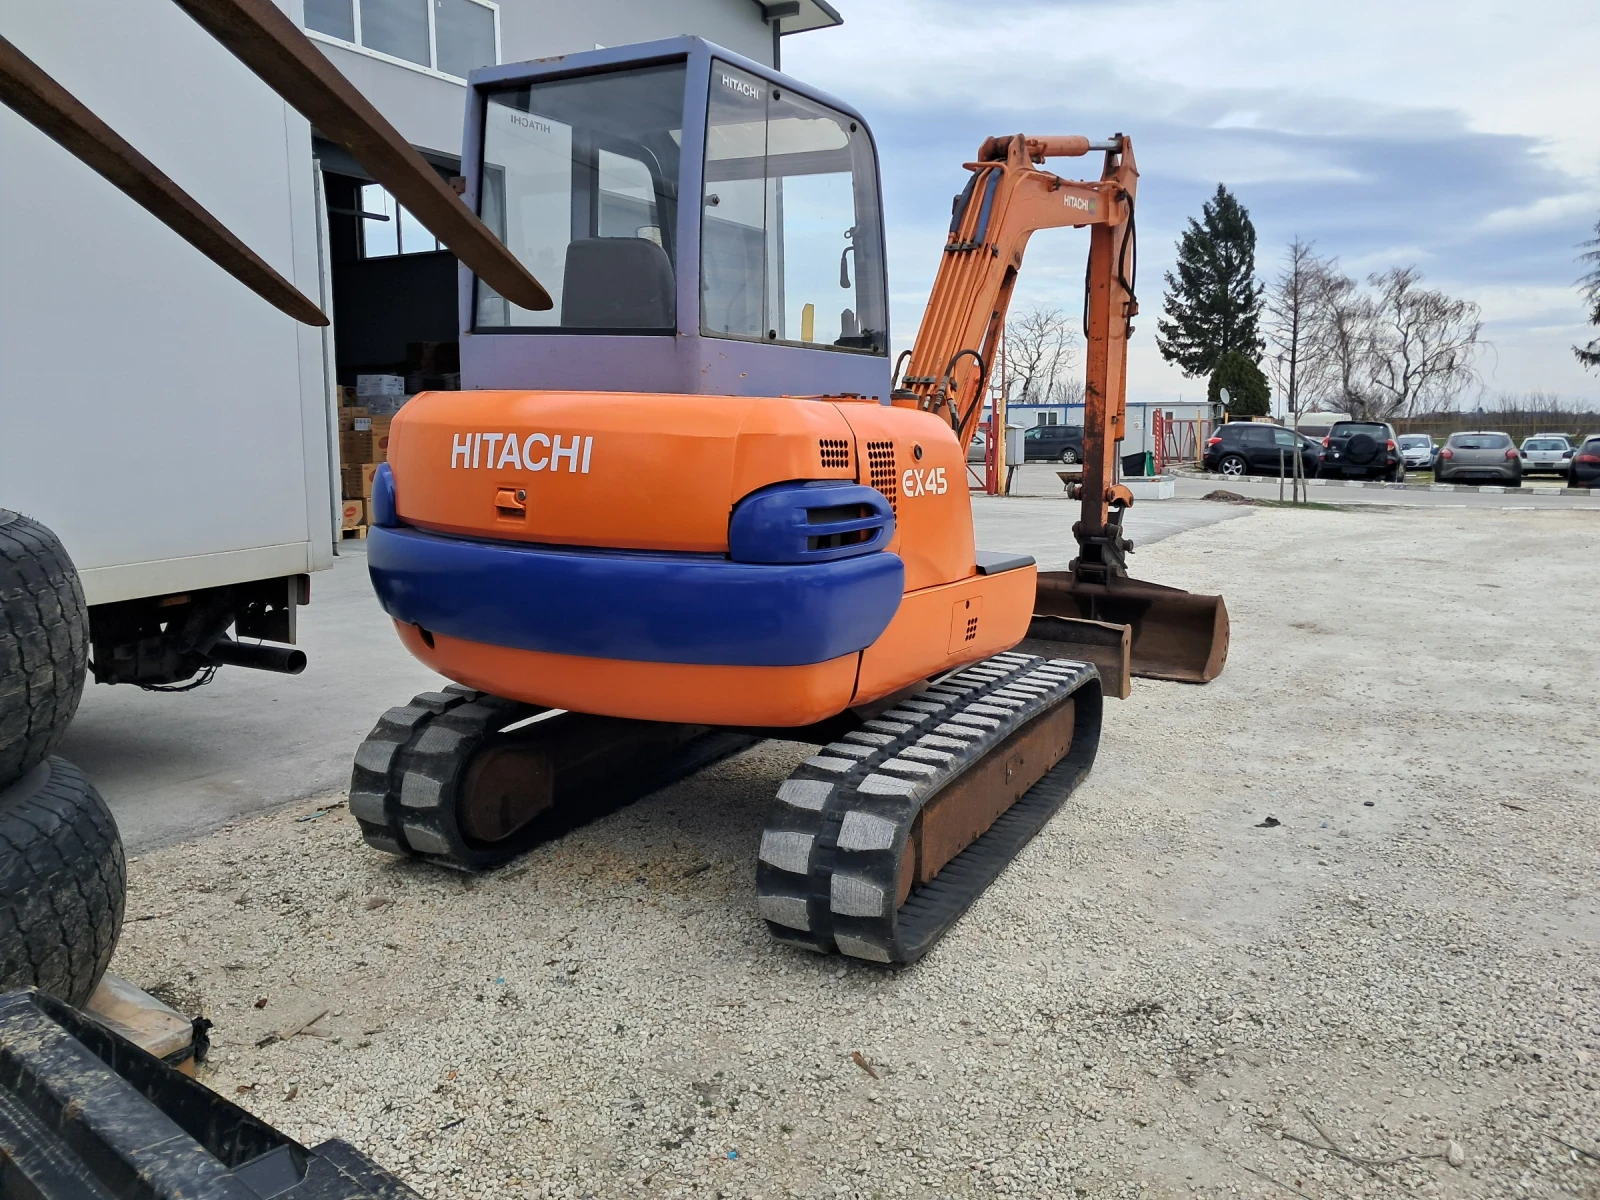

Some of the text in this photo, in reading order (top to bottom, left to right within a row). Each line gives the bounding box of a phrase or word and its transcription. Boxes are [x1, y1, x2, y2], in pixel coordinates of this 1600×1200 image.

[722, 74, 759, 100] HITACHI
[1063, 194, 1089, 211] HITACHI
[451, 432, 594, 474] HITACHI
[902, 467, 948, 498] EX45
